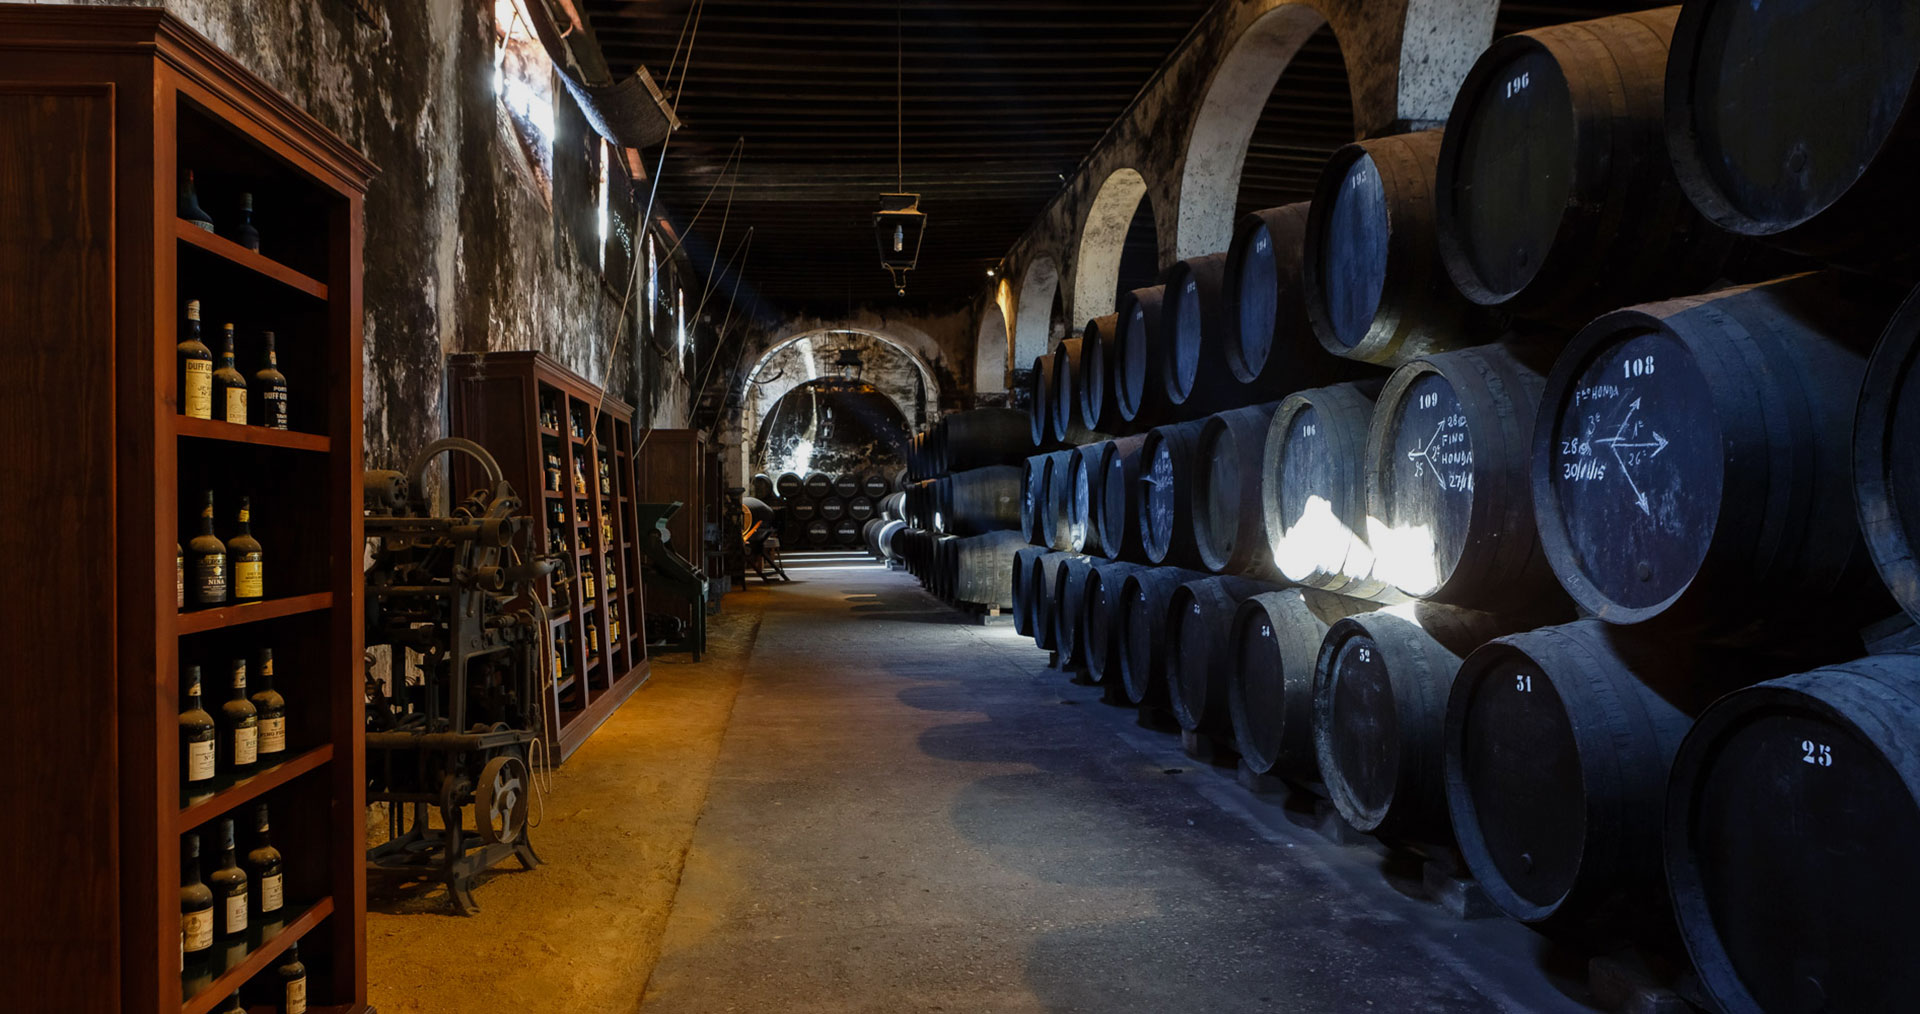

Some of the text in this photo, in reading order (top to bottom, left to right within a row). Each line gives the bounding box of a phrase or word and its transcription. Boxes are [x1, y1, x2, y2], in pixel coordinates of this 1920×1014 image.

[1506, 71, 1530, 99] 196
[1352, 170, 1366, 189] 195
[187, 361, 204, 371] DUFF
[1623, 355, 1655, 379] 108
[1591, 384, 1619, 400] HONDA
[1419, 392, 1438, 409] 109
[1303, 424, 1316, 438] 106
[1442, 433, 1464, 447] FINO
[1442, 450, 1473, 466] HONDA
[1801, 739, 1833, 767] 25
